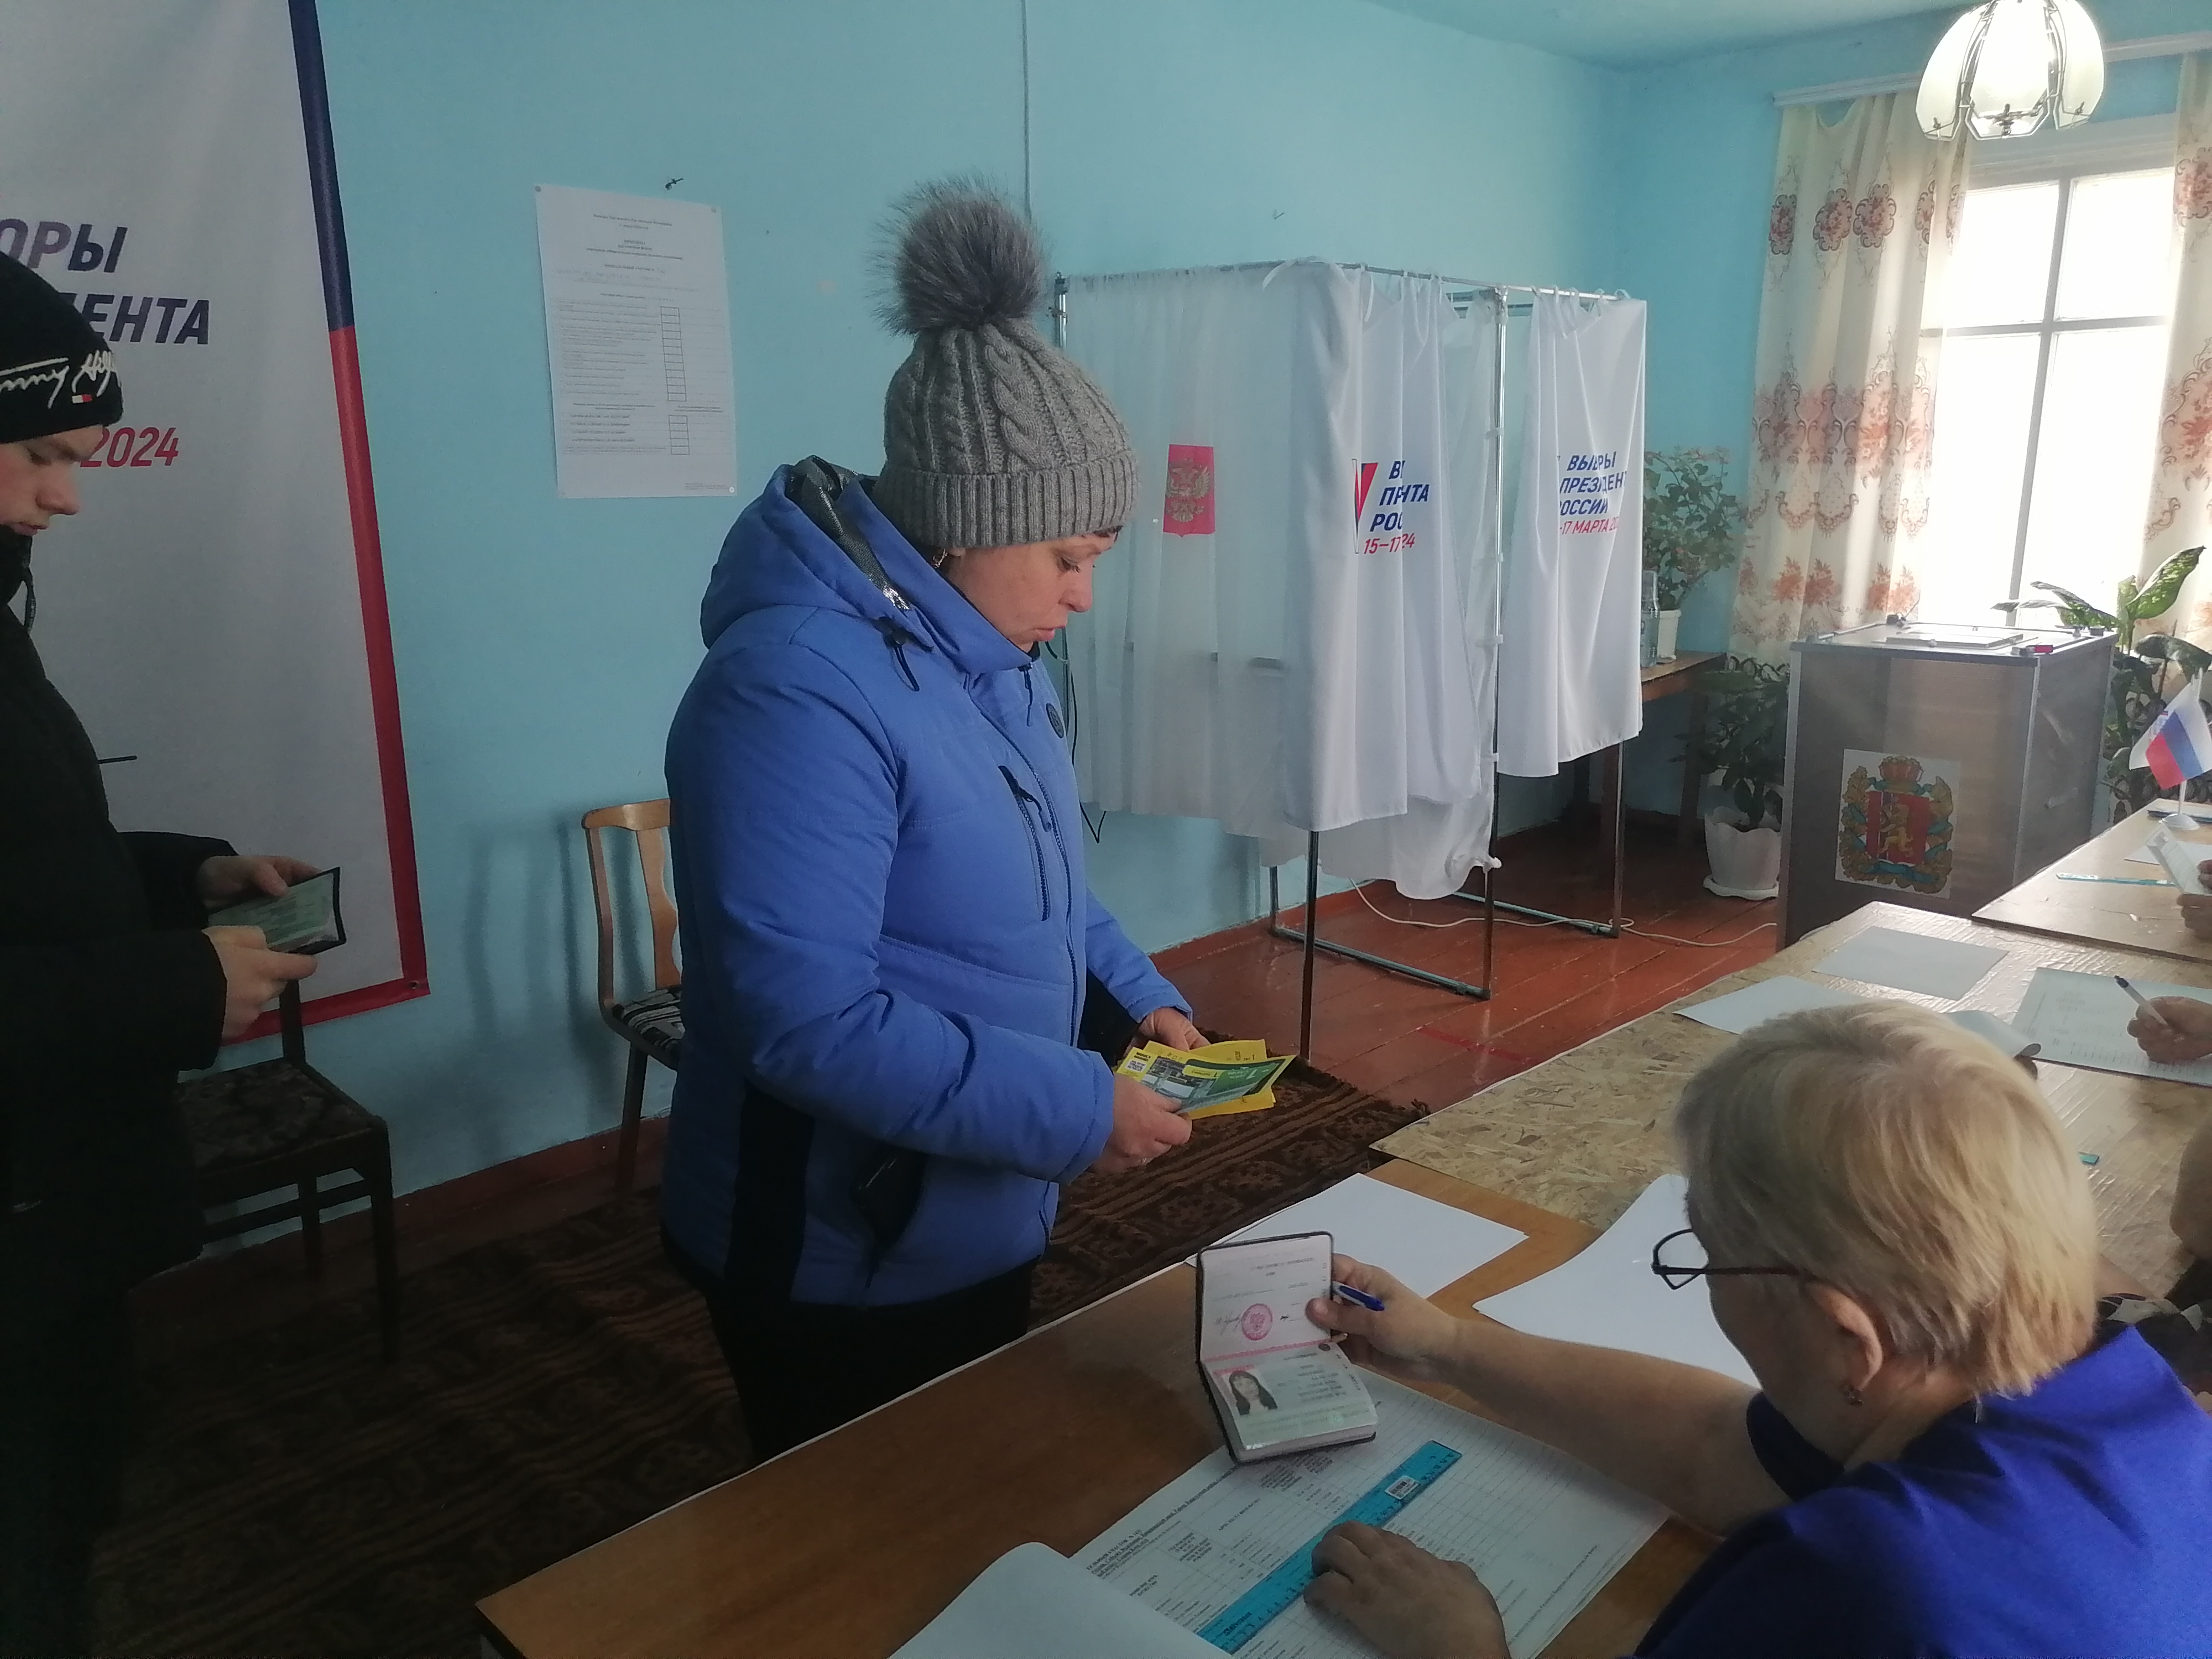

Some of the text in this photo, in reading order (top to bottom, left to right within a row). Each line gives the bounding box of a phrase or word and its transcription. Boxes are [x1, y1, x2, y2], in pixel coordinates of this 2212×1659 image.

[80, 426, 179, 468] 2024
[1559, 498, 1609, 516] ОССИИ
[1572, 518, 1609, 534] МАРТА
